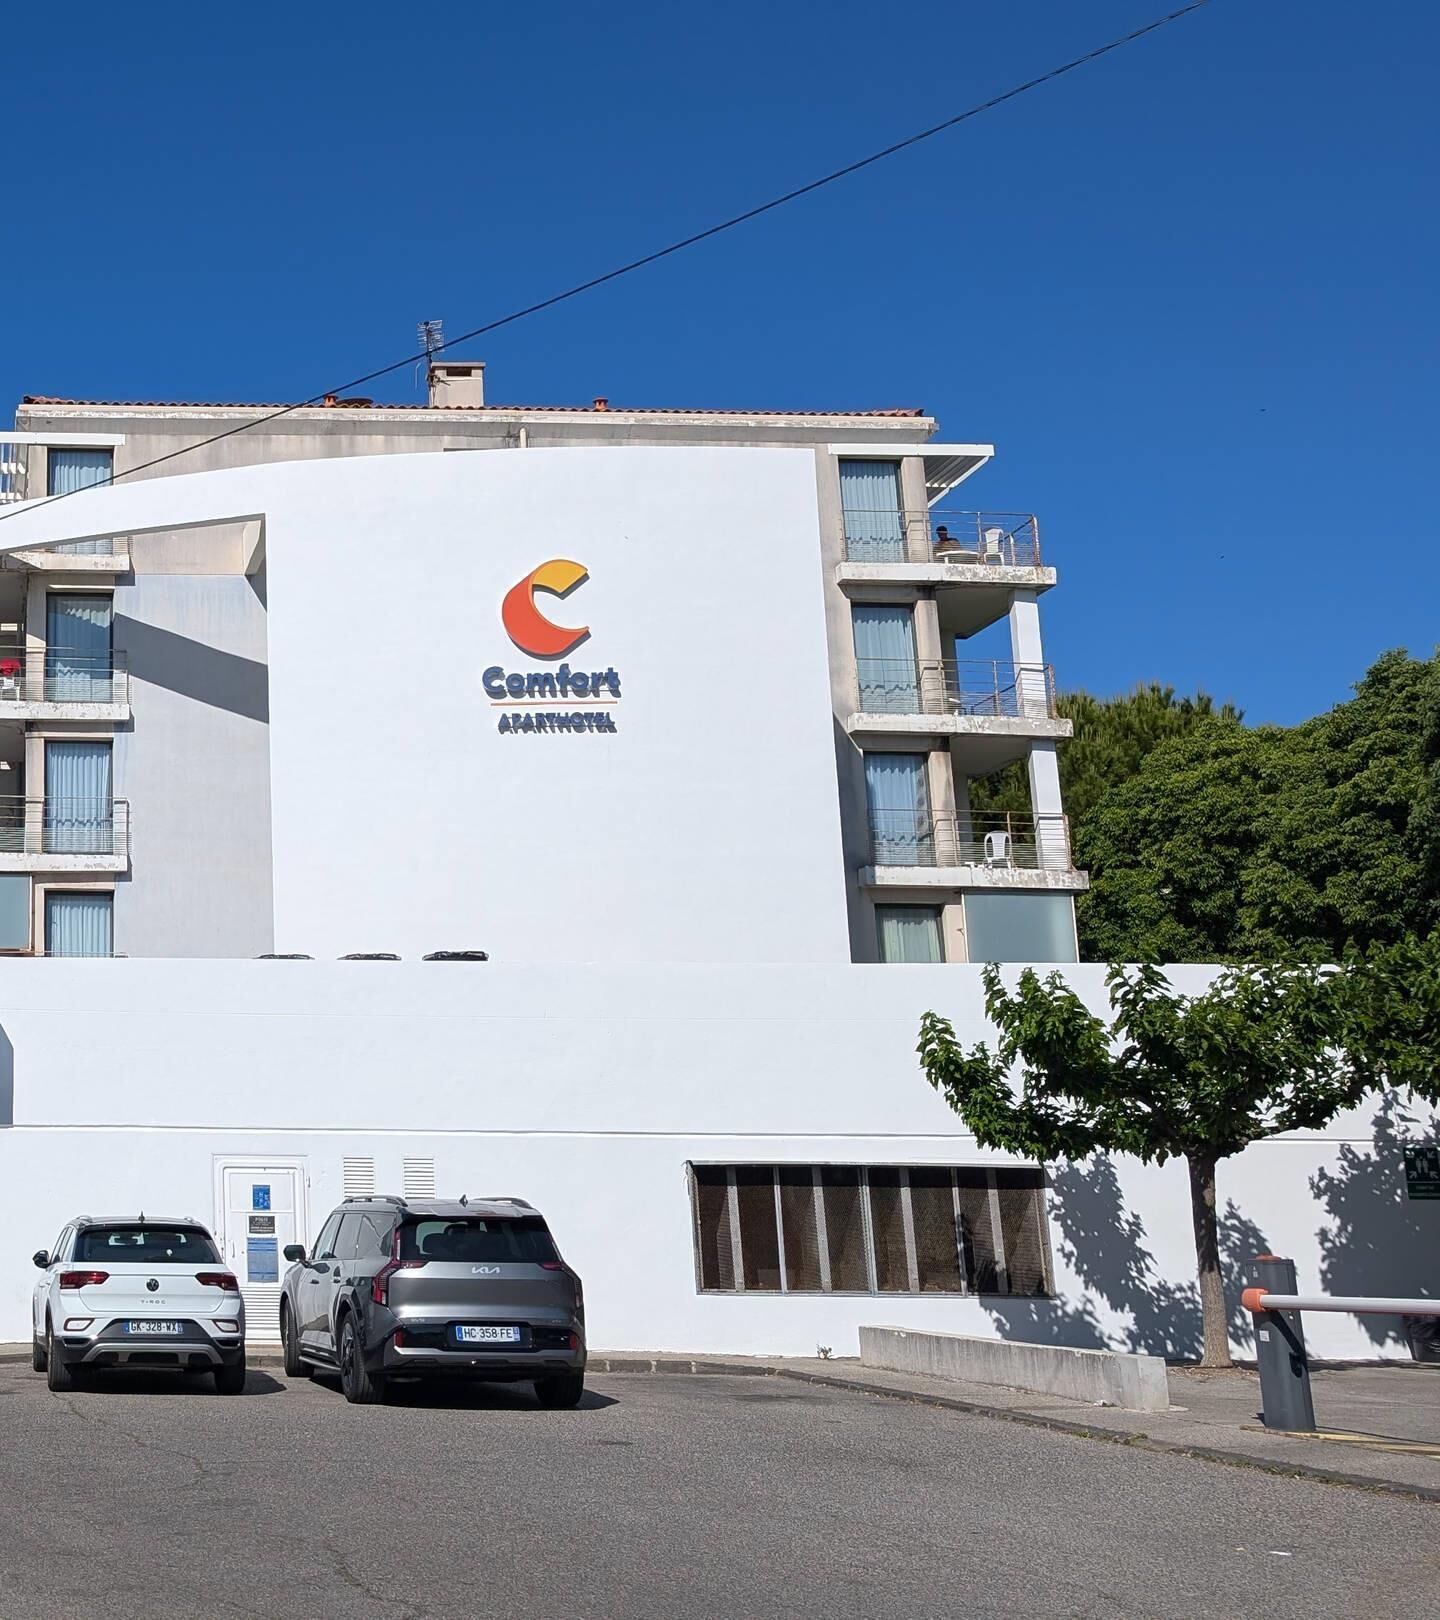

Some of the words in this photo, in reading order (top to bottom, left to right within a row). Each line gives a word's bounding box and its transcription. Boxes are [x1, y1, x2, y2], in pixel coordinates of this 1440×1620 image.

[482, 663, 620, 697] Comfort
[498, 712, 616, 732] APARTHOTEL
[131, 1321, 177, 1332] GK-328-WX
[463, 1327, 513, 1339] HC-358-FE
